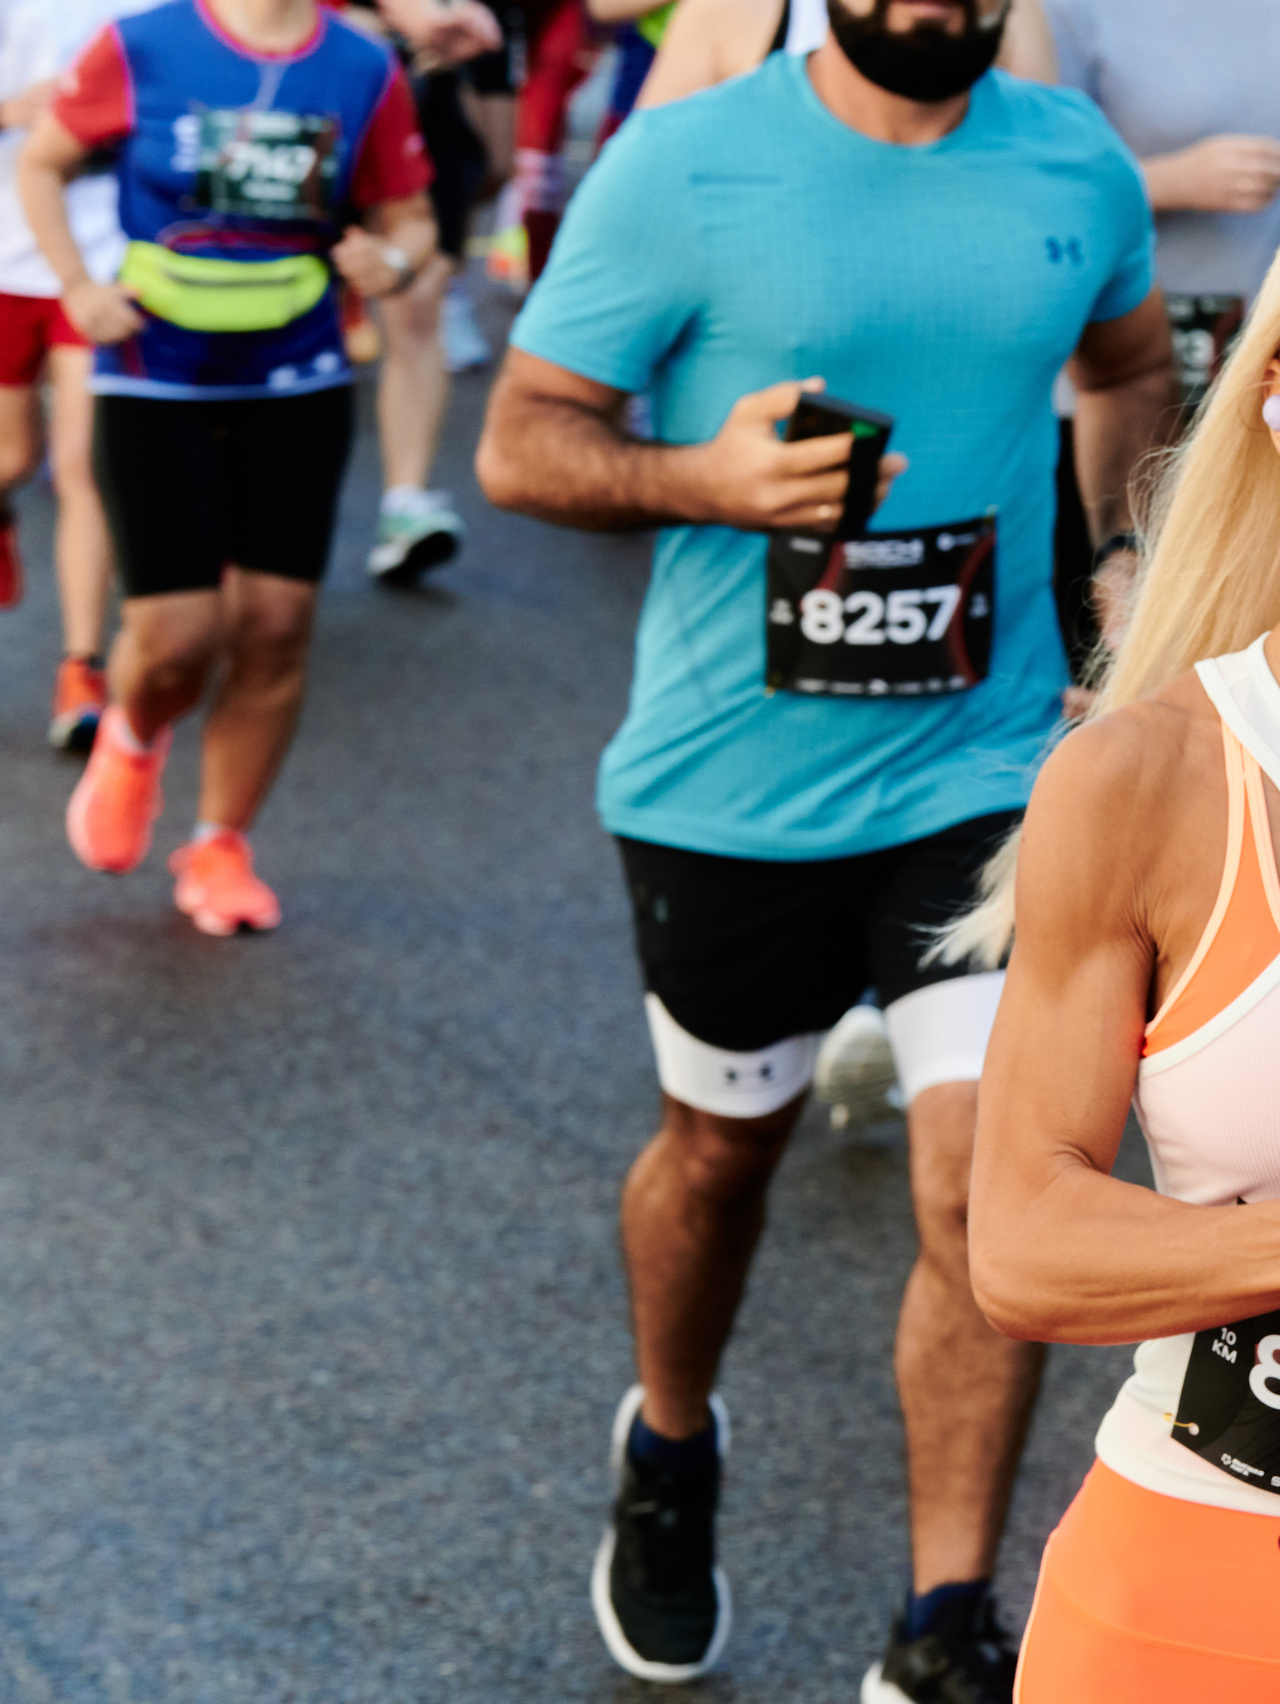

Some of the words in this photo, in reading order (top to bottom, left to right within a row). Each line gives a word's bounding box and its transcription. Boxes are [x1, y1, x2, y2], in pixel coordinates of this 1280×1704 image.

[801, 584, 961, 645] 8257
[1221, 1327, 1237, 1346] 10
[1212, 1338, 1238, 1364] KM
